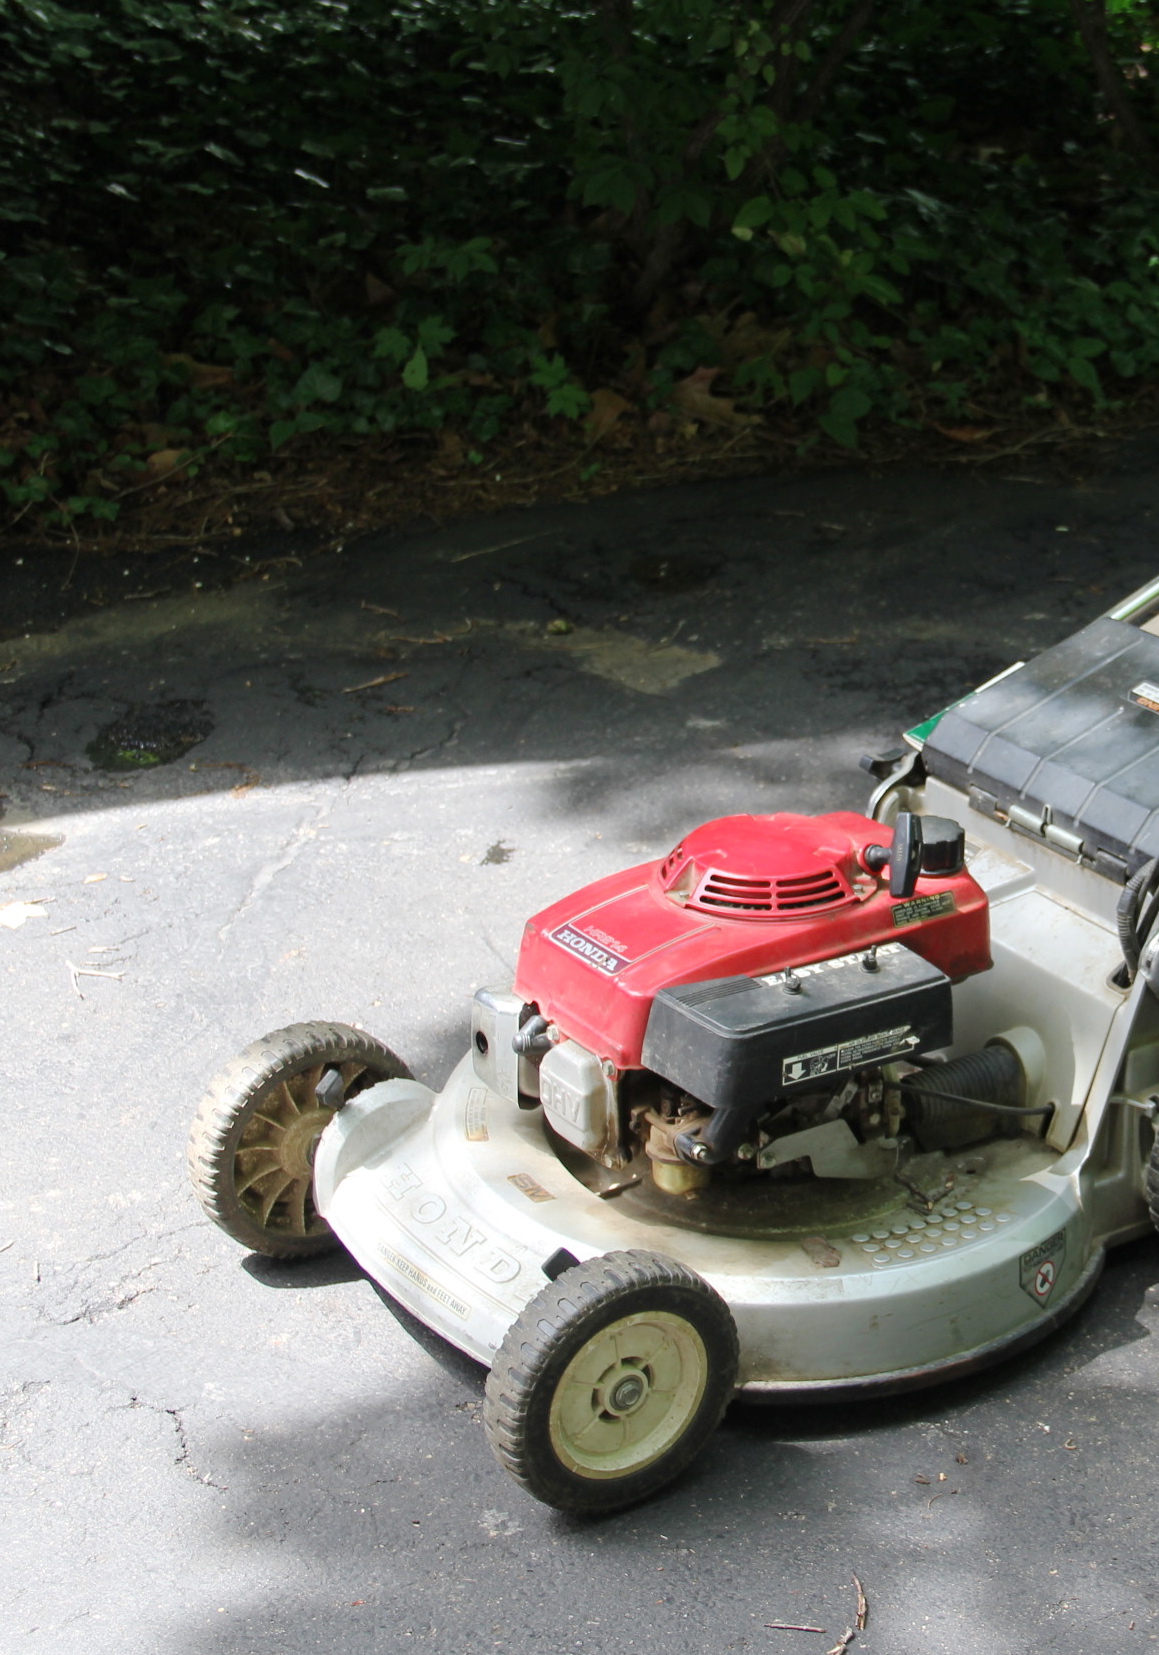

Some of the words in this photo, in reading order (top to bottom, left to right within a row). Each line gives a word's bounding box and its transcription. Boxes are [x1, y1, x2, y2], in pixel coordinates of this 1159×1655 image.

[903, 894, 940, 908] WARNING
[556, 929, 618, 971] HONDA
[379, 1161, 540, 1303] HOND
[408, 1265, 428, 1287] HANDS
[426, 1283, 438, 1295] and
[437, 1289, 452, 1304] FEET
[449, 1299, 467, 1315] AWAY
